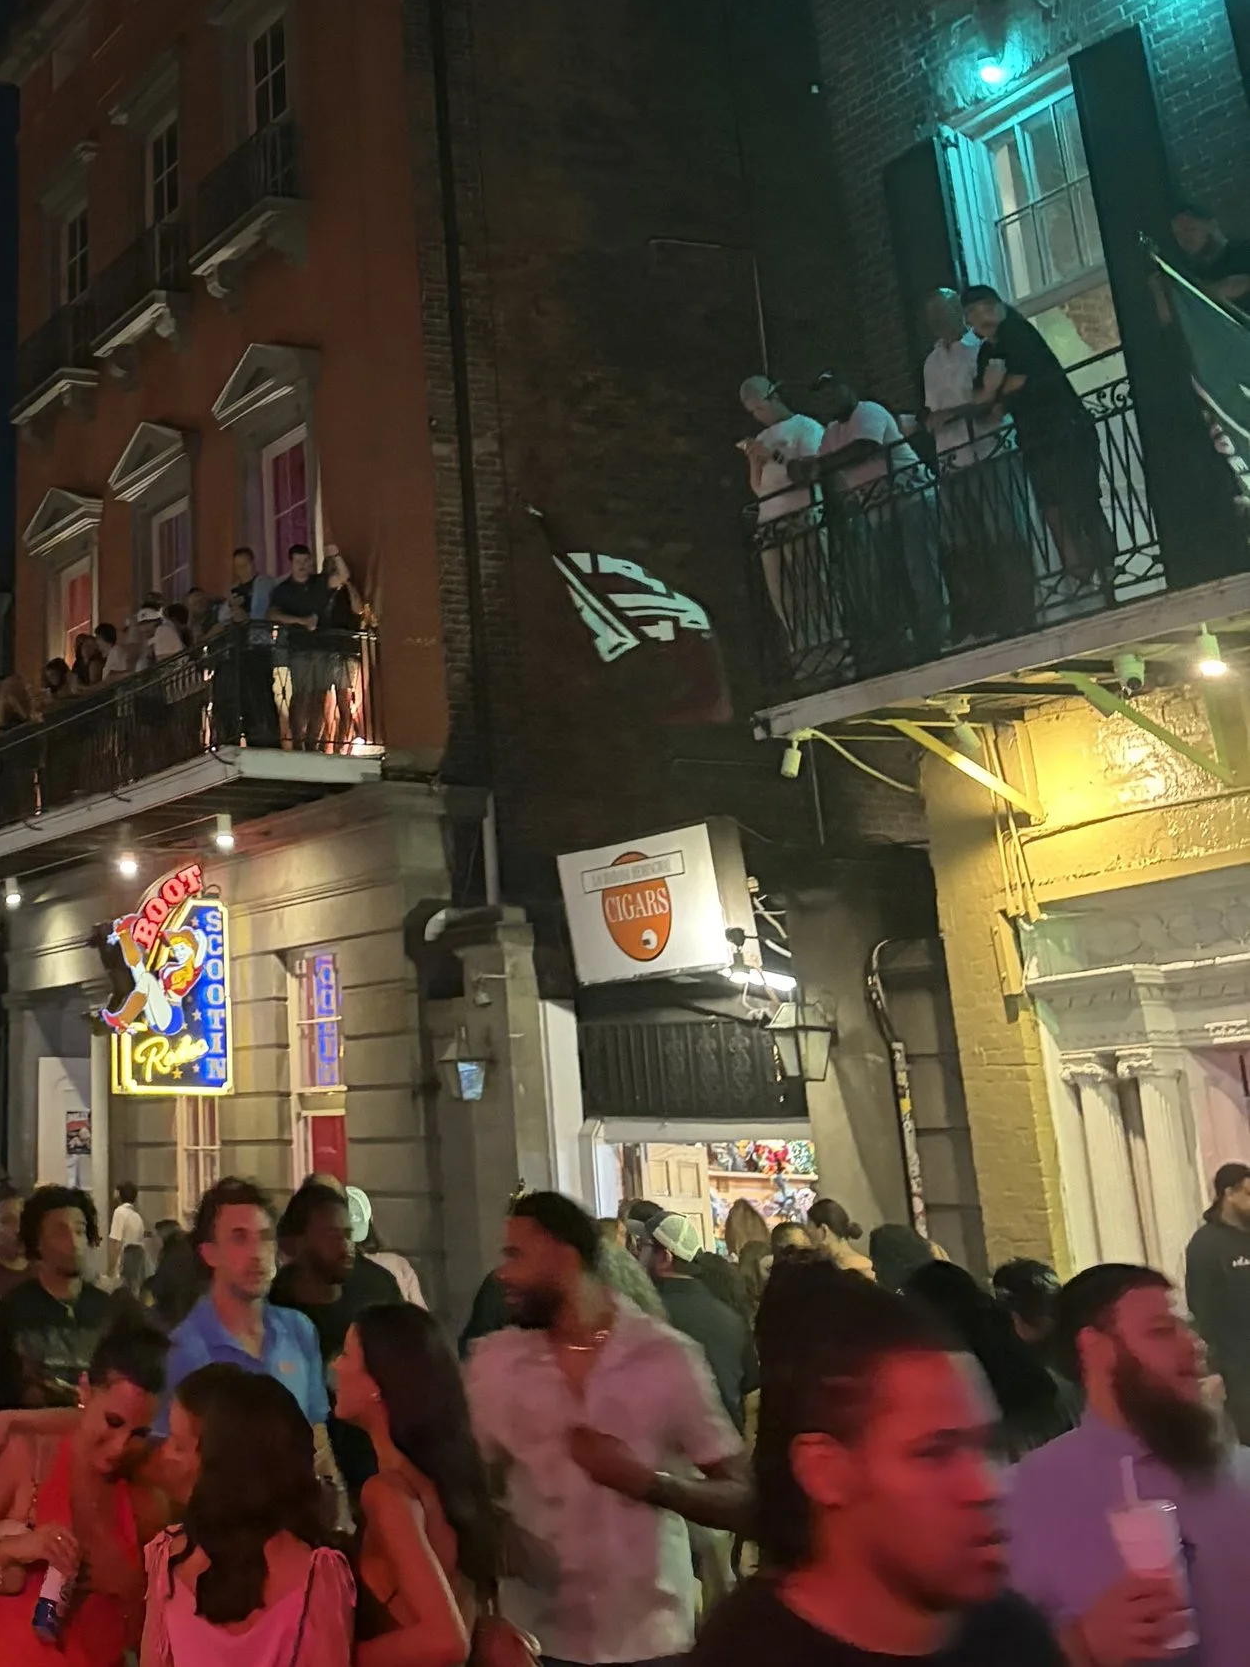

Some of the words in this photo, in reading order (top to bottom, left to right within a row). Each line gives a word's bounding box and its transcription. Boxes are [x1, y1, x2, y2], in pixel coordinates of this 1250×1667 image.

[132, 864, 202, 950] BOOT
[605, 887, 669, 923] CIGARS
[205, 910, 227, 1080] SCOOTIN
